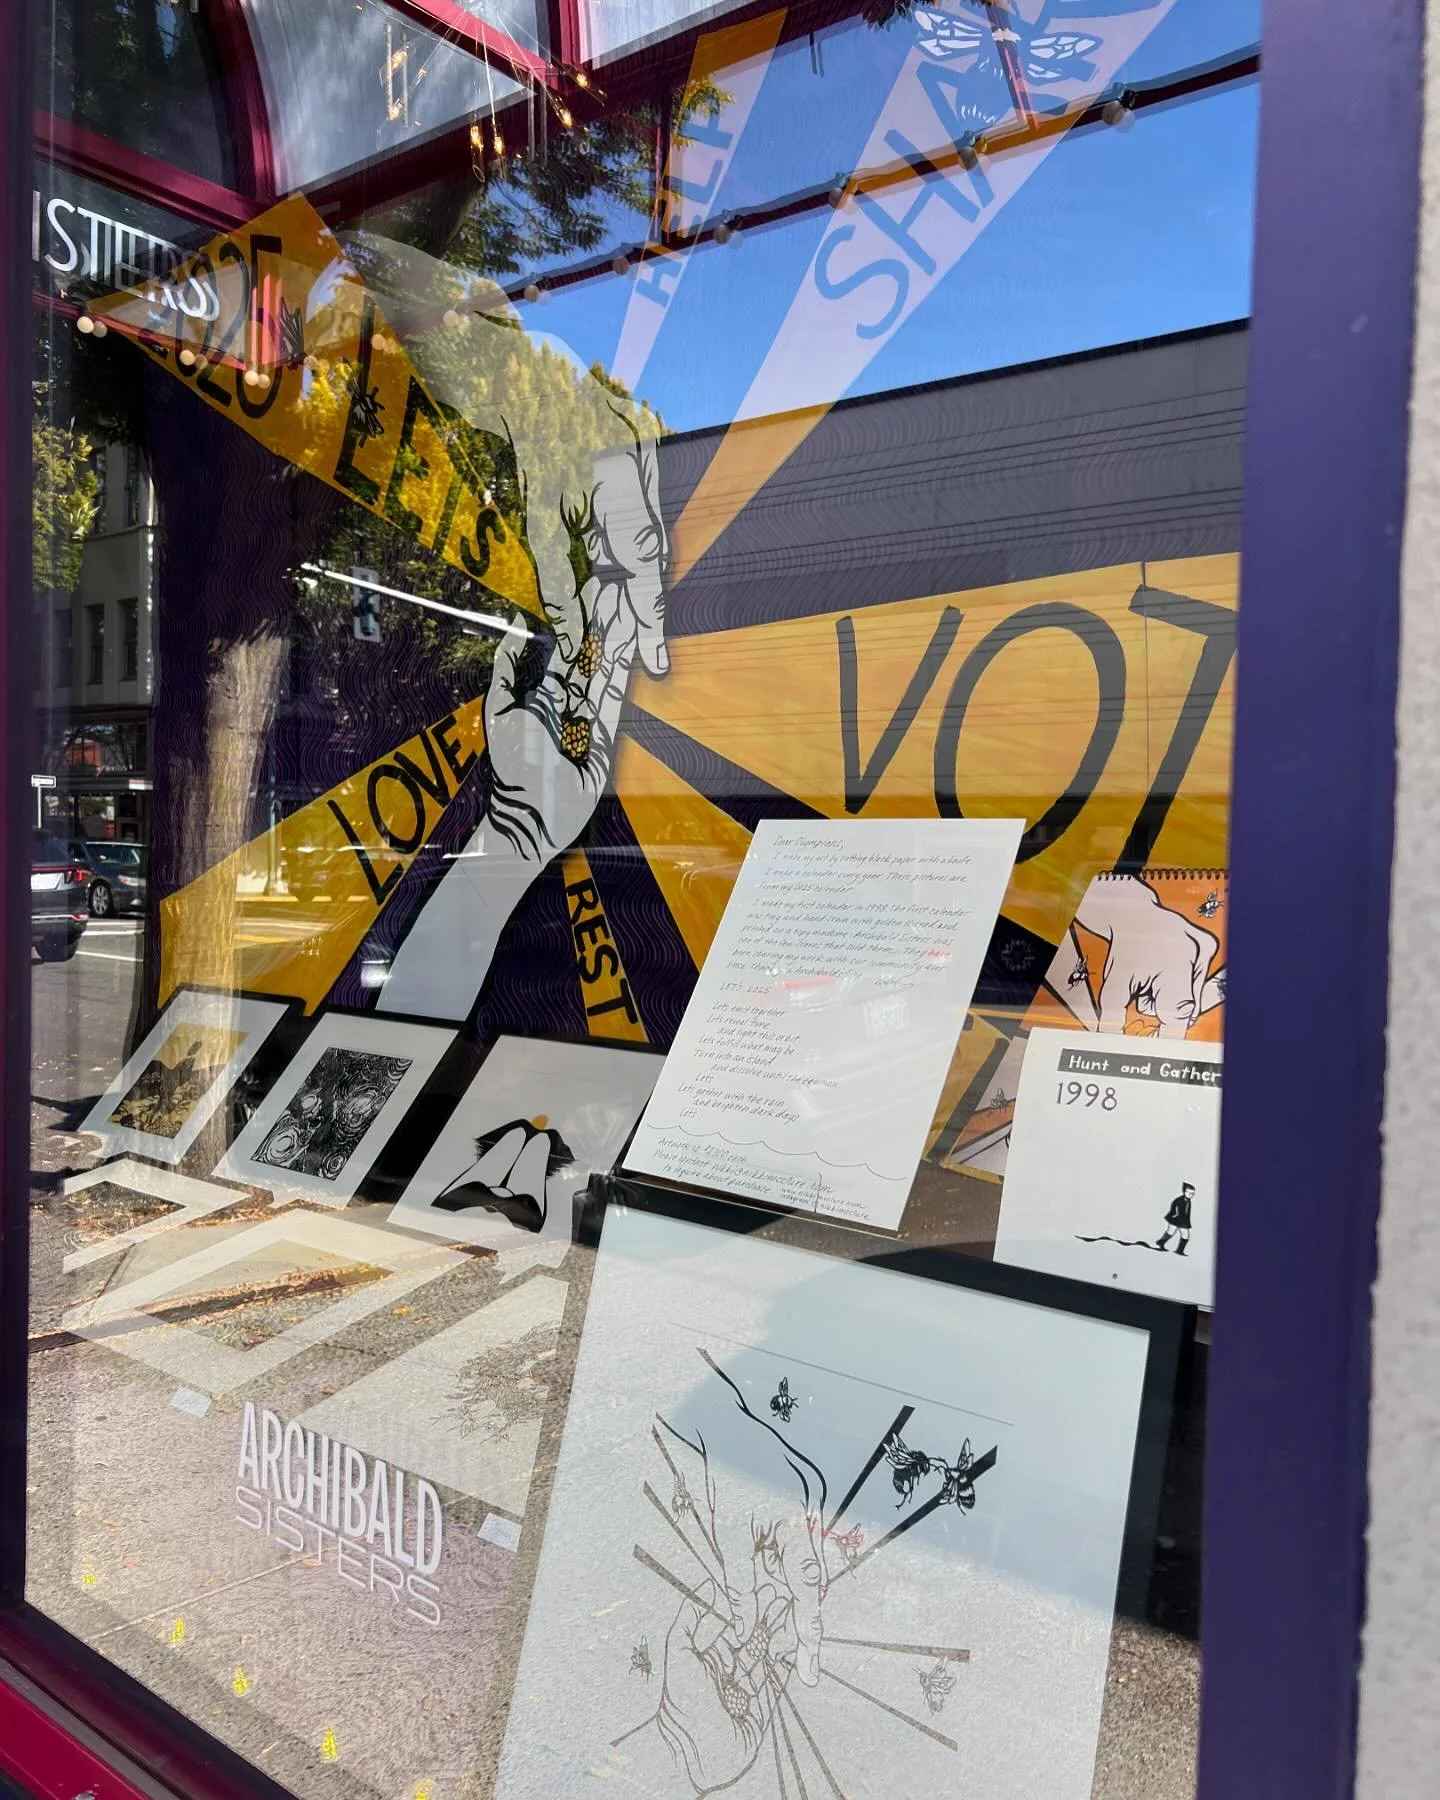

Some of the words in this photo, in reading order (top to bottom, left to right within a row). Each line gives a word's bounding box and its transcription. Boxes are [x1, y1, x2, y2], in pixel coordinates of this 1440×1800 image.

[327, 714, 478, 906] LOVE
[565, 879, 638, 1025] REST
[1056, 1081, 1118, 1111] 1998
[1069, 1055, 1110, 1072] Hunt
[1121, 1063, 1151, 1076] and
[1160, 1063, 1222, 1082] Gather
[236, 1485, 440, 1626] SISTERS
[238, 1401, 442, 1575] ARCHIBALD
